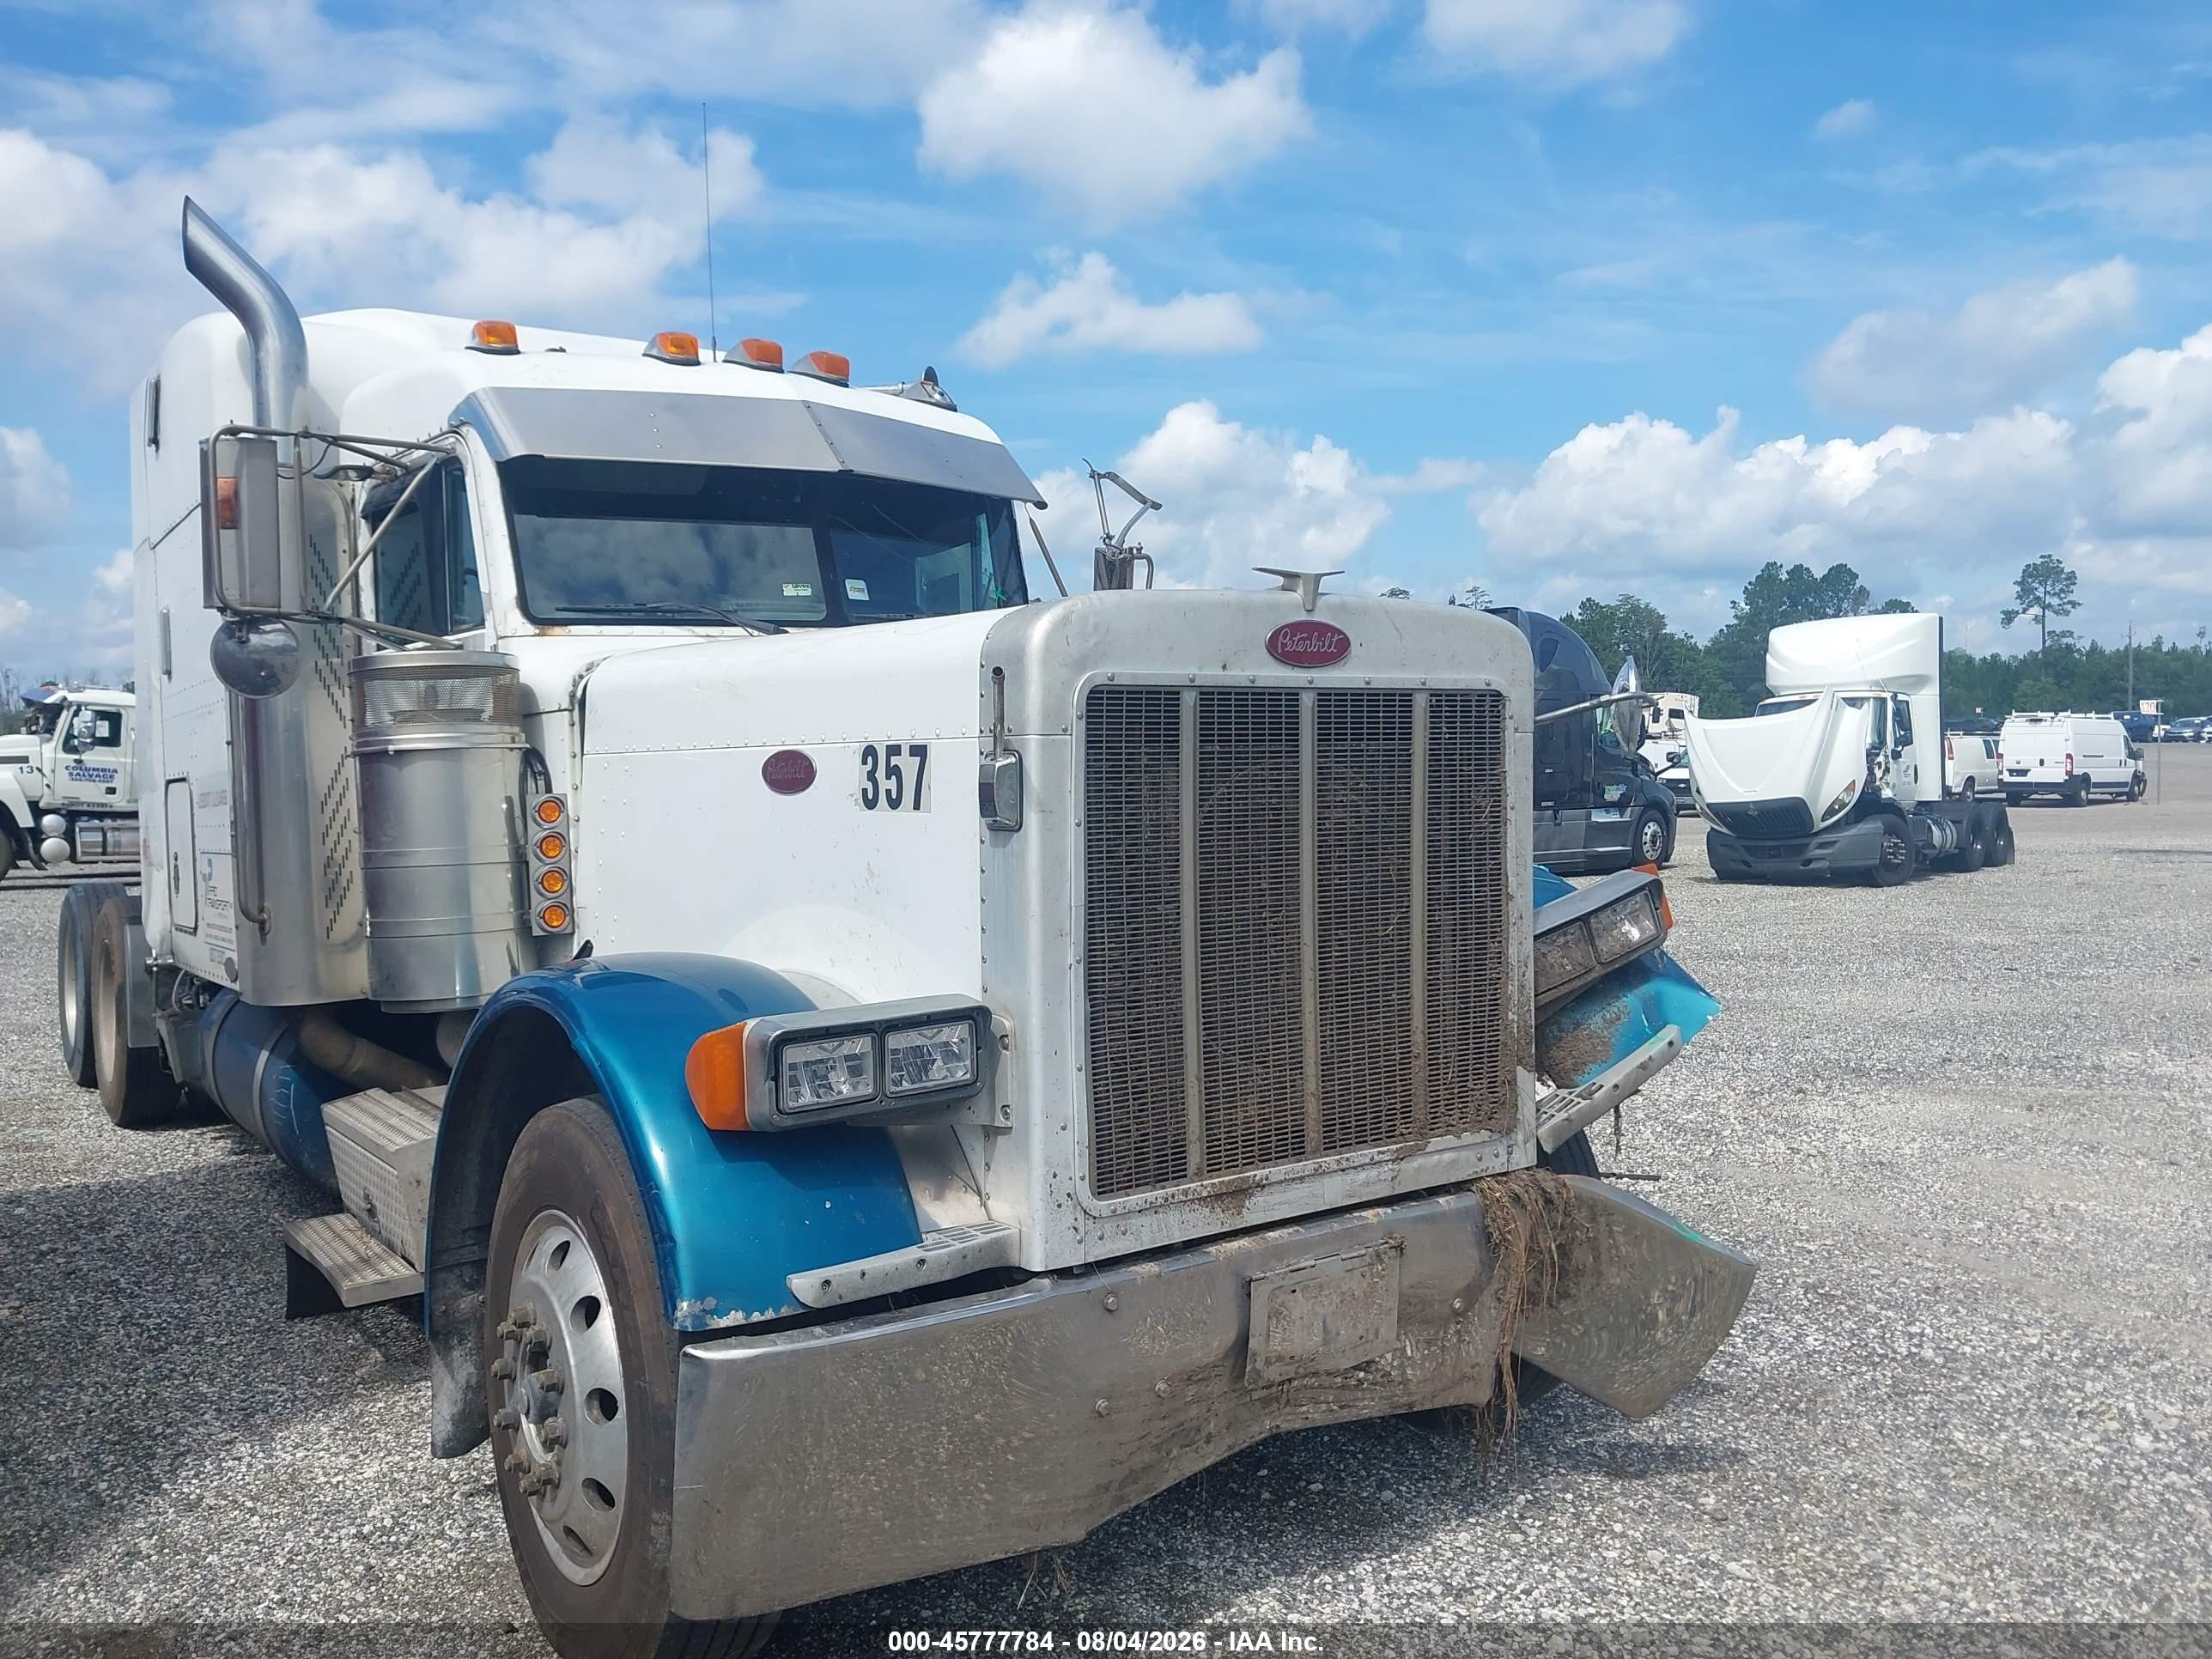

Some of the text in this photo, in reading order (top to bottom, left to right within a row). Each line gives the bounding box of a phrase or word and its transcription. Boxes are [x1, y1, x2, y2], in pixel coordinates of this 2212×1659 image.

[1278, 628, 1345, 653] Peterbilt
[18, 765, 34, 775] 13
[64, 765, 118, 775] COLUMBIA
[68, 771, 115, 780] SALVAGE
[861, 744, 928, 811] 357
